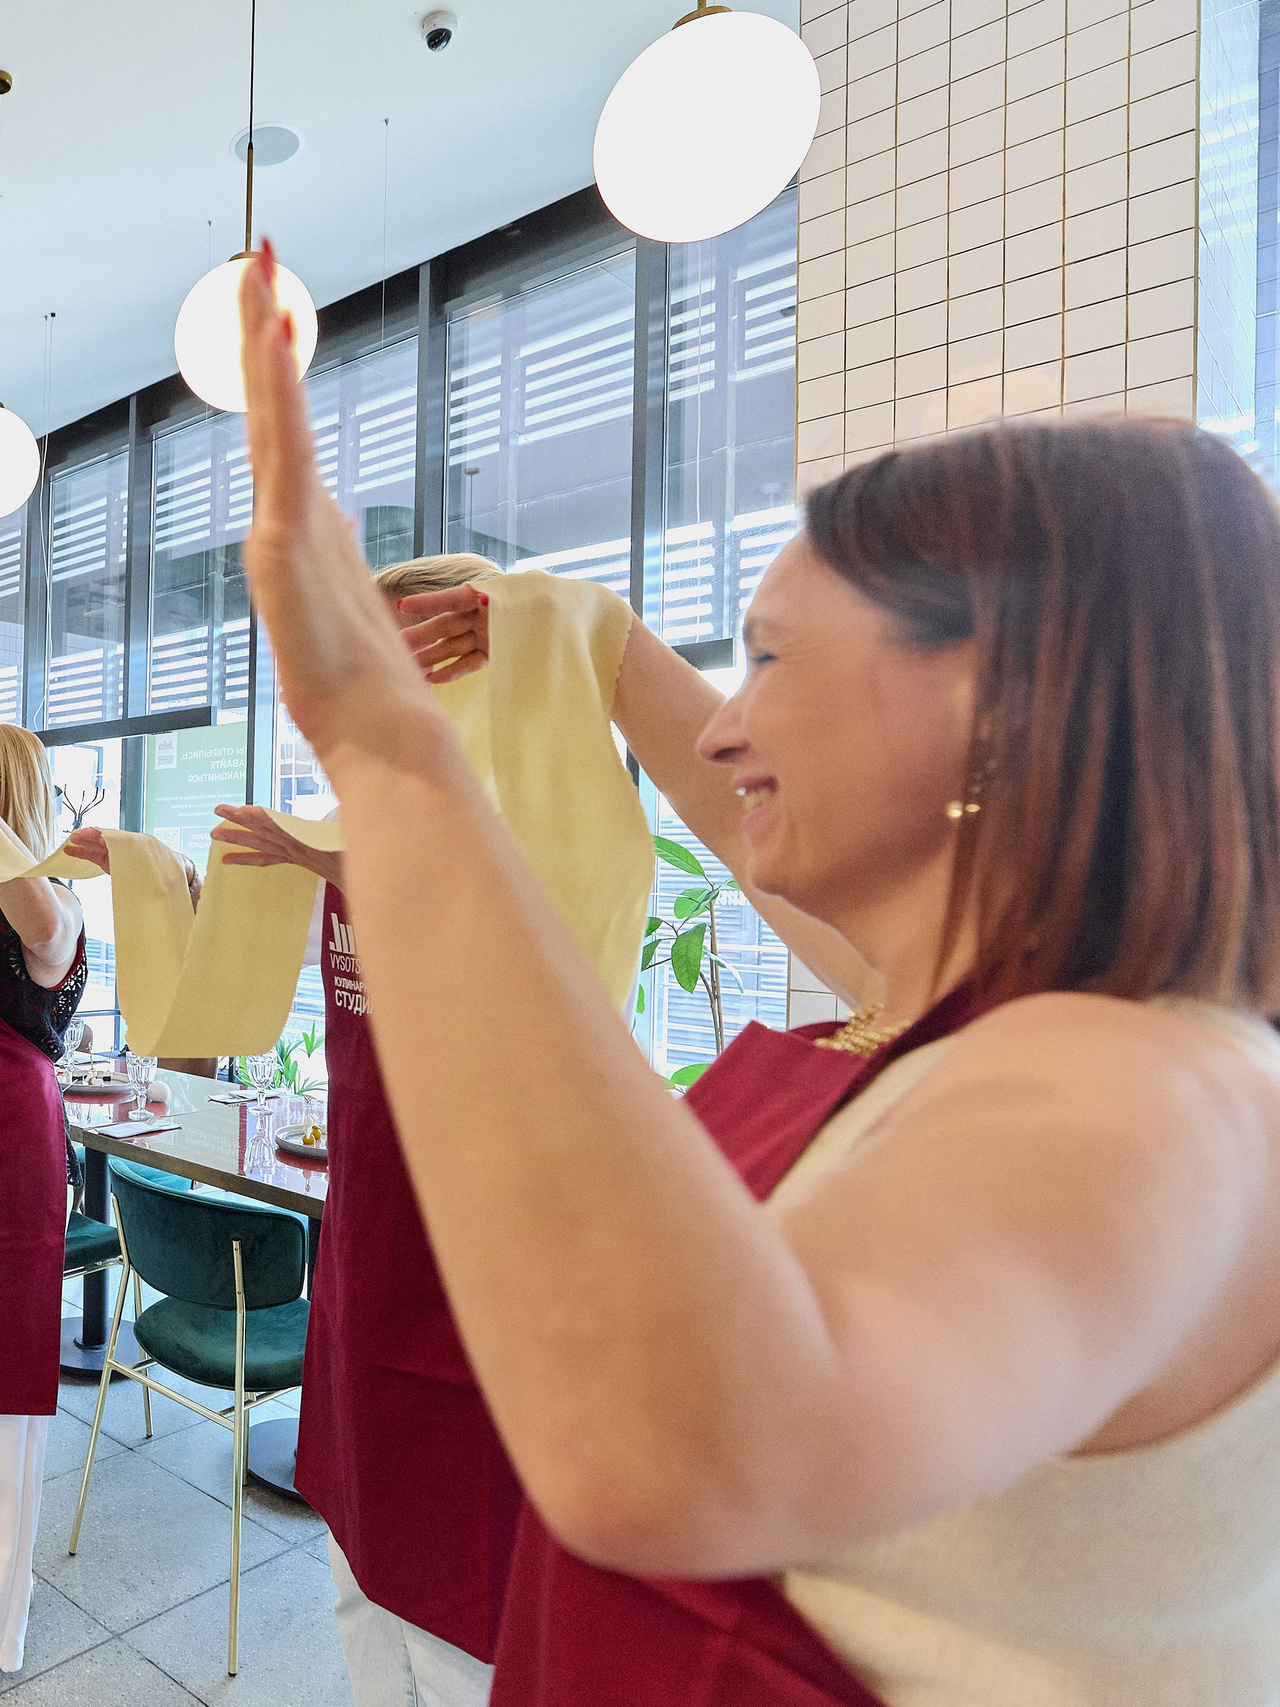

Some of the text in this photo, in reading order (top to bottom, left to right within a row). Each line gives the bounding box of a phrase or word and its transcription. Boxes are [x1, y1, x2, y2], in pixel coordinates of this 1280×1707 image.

[329, 952, 363, 975] VYSOTS
[334, 975, 368, 992] КУЛИНАР
[335, 989, 373, 1016] СТУДИ
